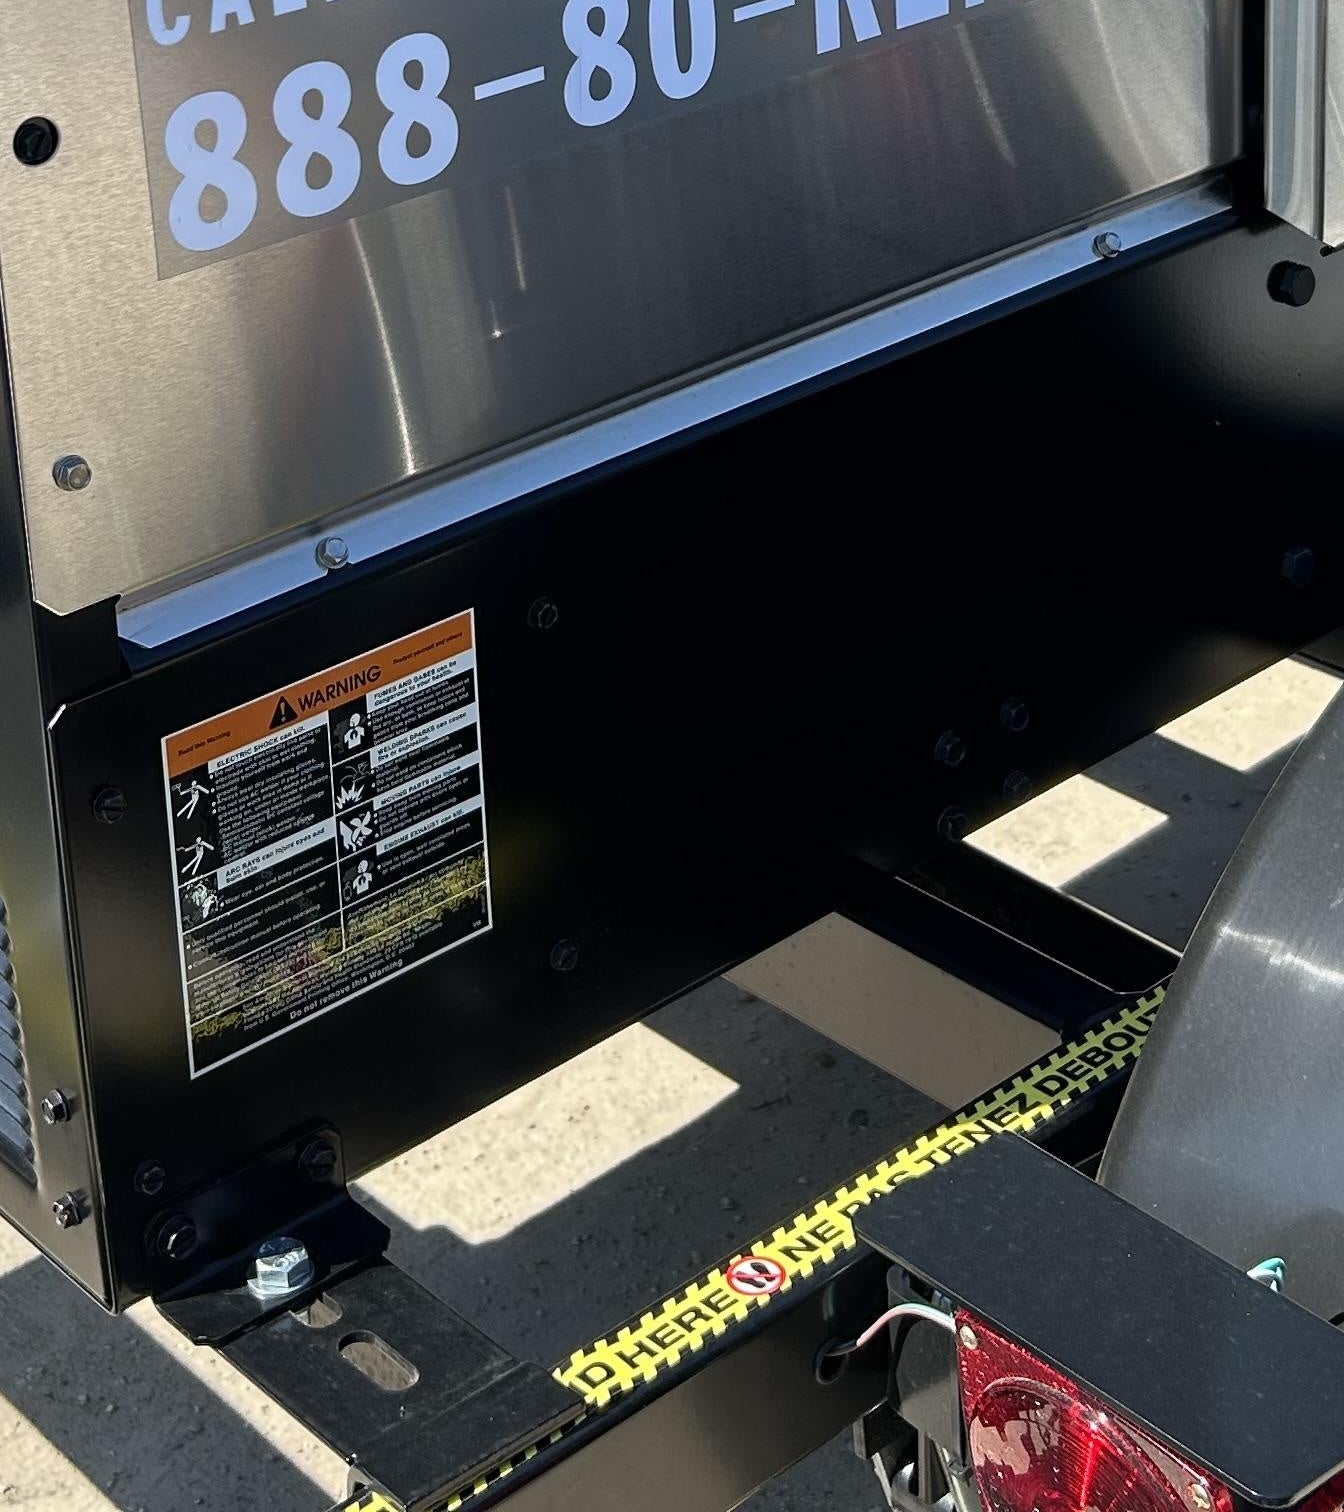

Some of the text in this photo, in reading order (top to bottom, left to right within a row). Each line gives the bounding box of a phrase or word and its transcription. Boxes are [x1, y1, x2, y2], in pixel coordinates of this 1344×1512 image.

[297, 665, 382, 714] WARNING
[217, 748, 252, 768] ELECTRIC
[254, 737, 278, 752] SHOCK
[409, 779, 429, 792] PARTS
[225, 865, 241, 877] ARC
[242, 857, 261, 870] RAYS
[262, 851, 274, 860] can
[296, 834, 311, 845] eyes
[313, 827, 325, 837] and
[410, 820, 439, 837] EXHAUST
[290, 958, 403, 1020] Do not remove this Warning
[778, 1218, 845, 1264] NE
[616, 1288, 740, 1368] HERE
